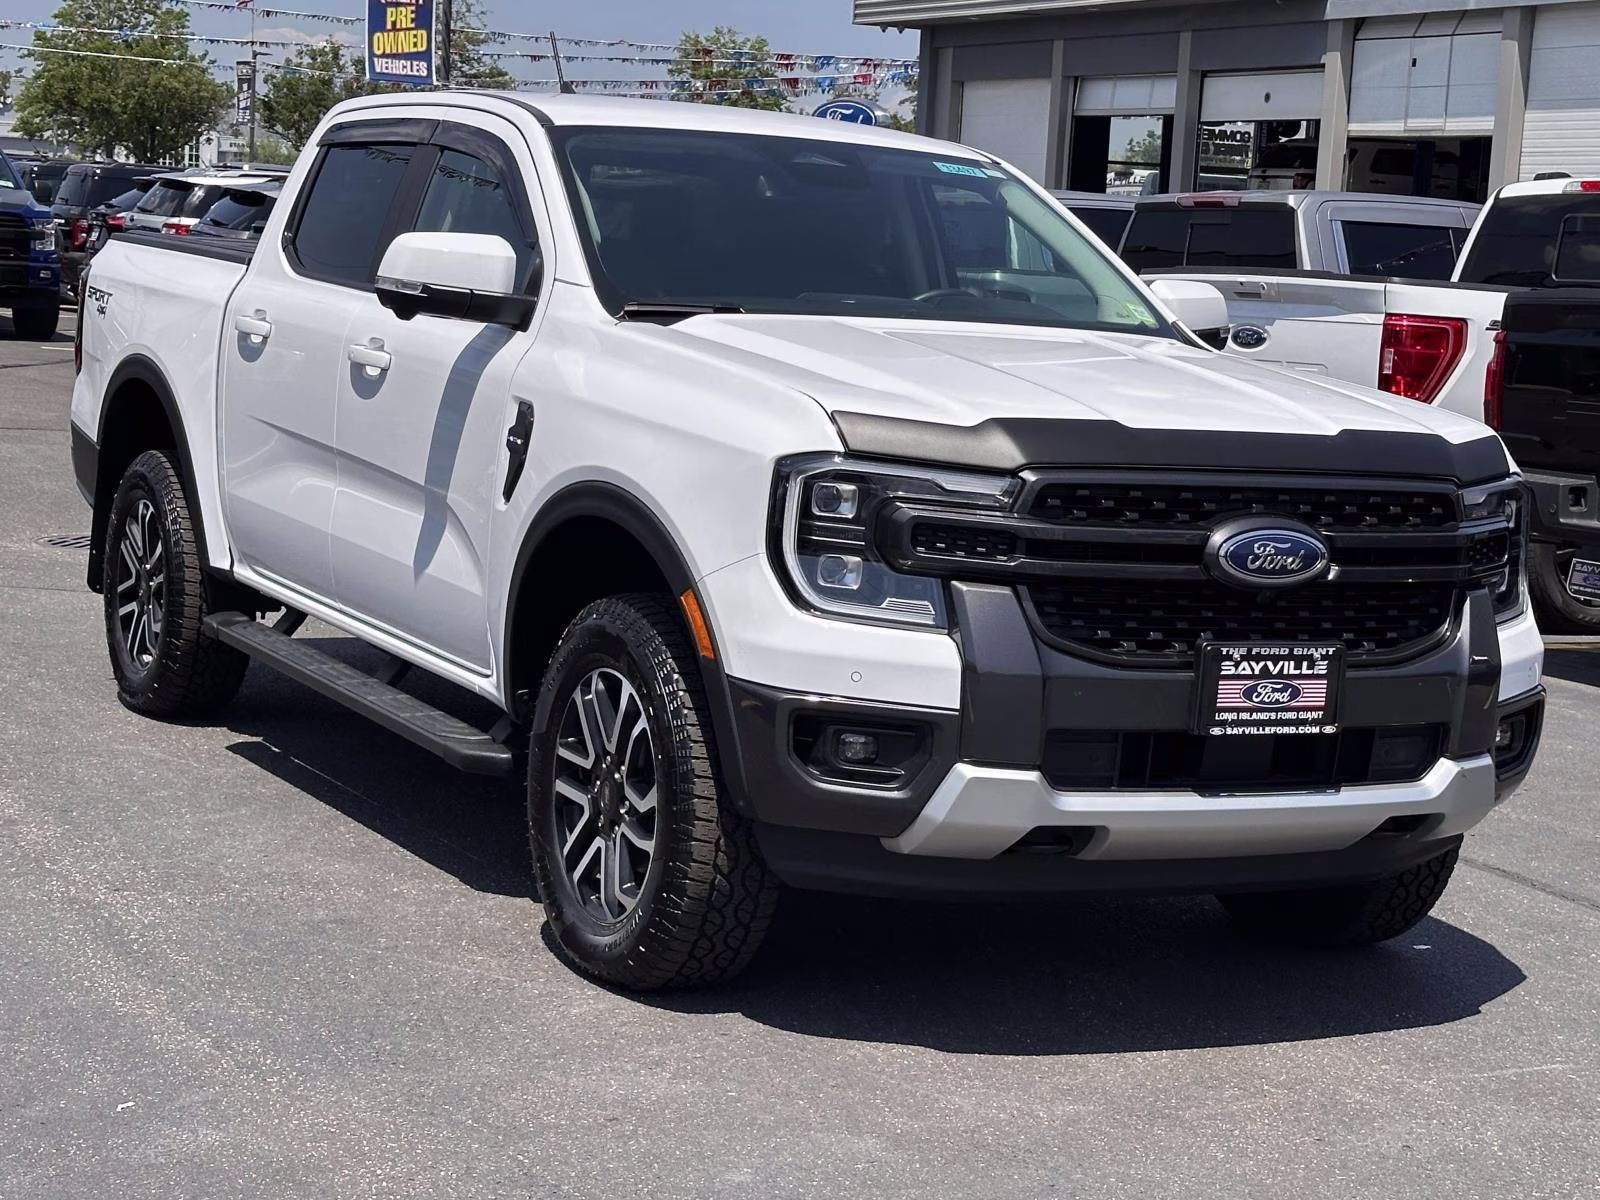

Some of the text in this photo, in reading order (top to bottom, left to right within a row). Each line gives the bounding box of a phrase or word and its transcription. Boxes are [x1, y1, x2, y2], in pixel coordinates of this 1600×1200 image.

[386, 6, 416, 30] PRE
[373, 29, 428, 55] OWNED
[373, 57, 428, 77] VEHICLES
[88, 285, 113, 306] SPORT
[1246, 541, 1305, 571] Ford
[1220, 647, 1336, 655] THE FORD GIANT
[1220, 660, 1329, 675] SAYVILLE
[1252, 683, 1291, 703] Ford
[1215, 711, 1323, 721] LONG ISLAND'S FORD GIANT
[1225, 726, 1320, 735] SAYVILLEFORD.COM
